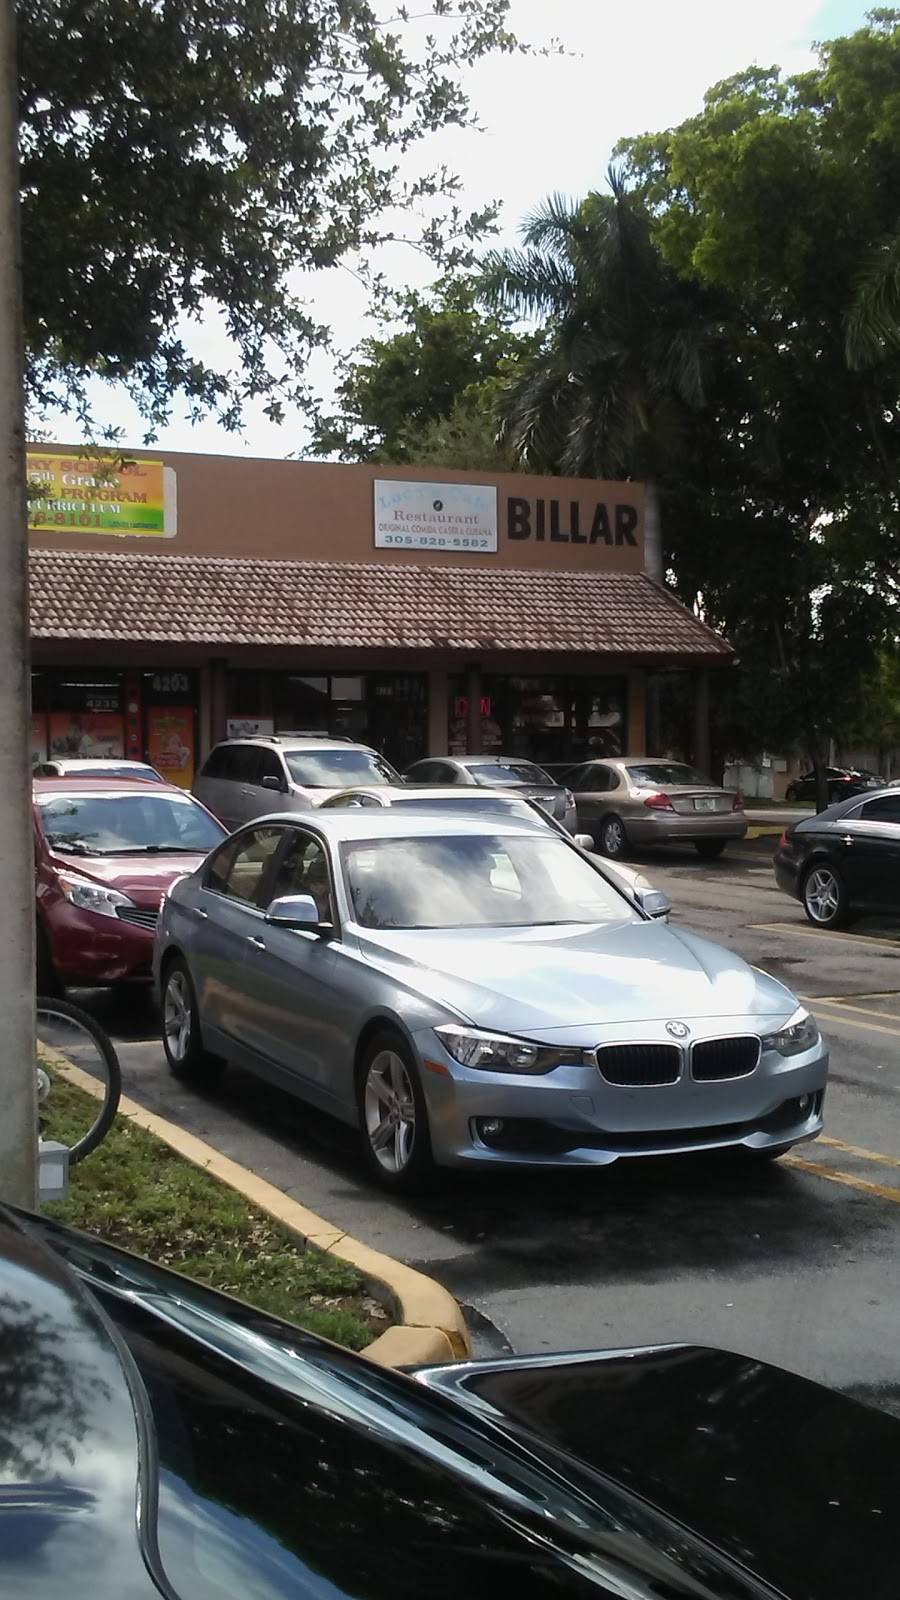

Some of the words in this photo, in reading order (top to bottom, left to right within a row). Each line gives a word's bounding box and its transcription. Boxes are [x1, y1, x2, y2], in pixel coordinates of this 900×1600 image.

[60, 459, 148, 478] SCHOL
[60, 487, 148, 504] PROGRAM
[392, 510, 480, 525] Restaurant
[507, 496, 638, 547] BILLAR
[455, 696, 491, 718] ON
